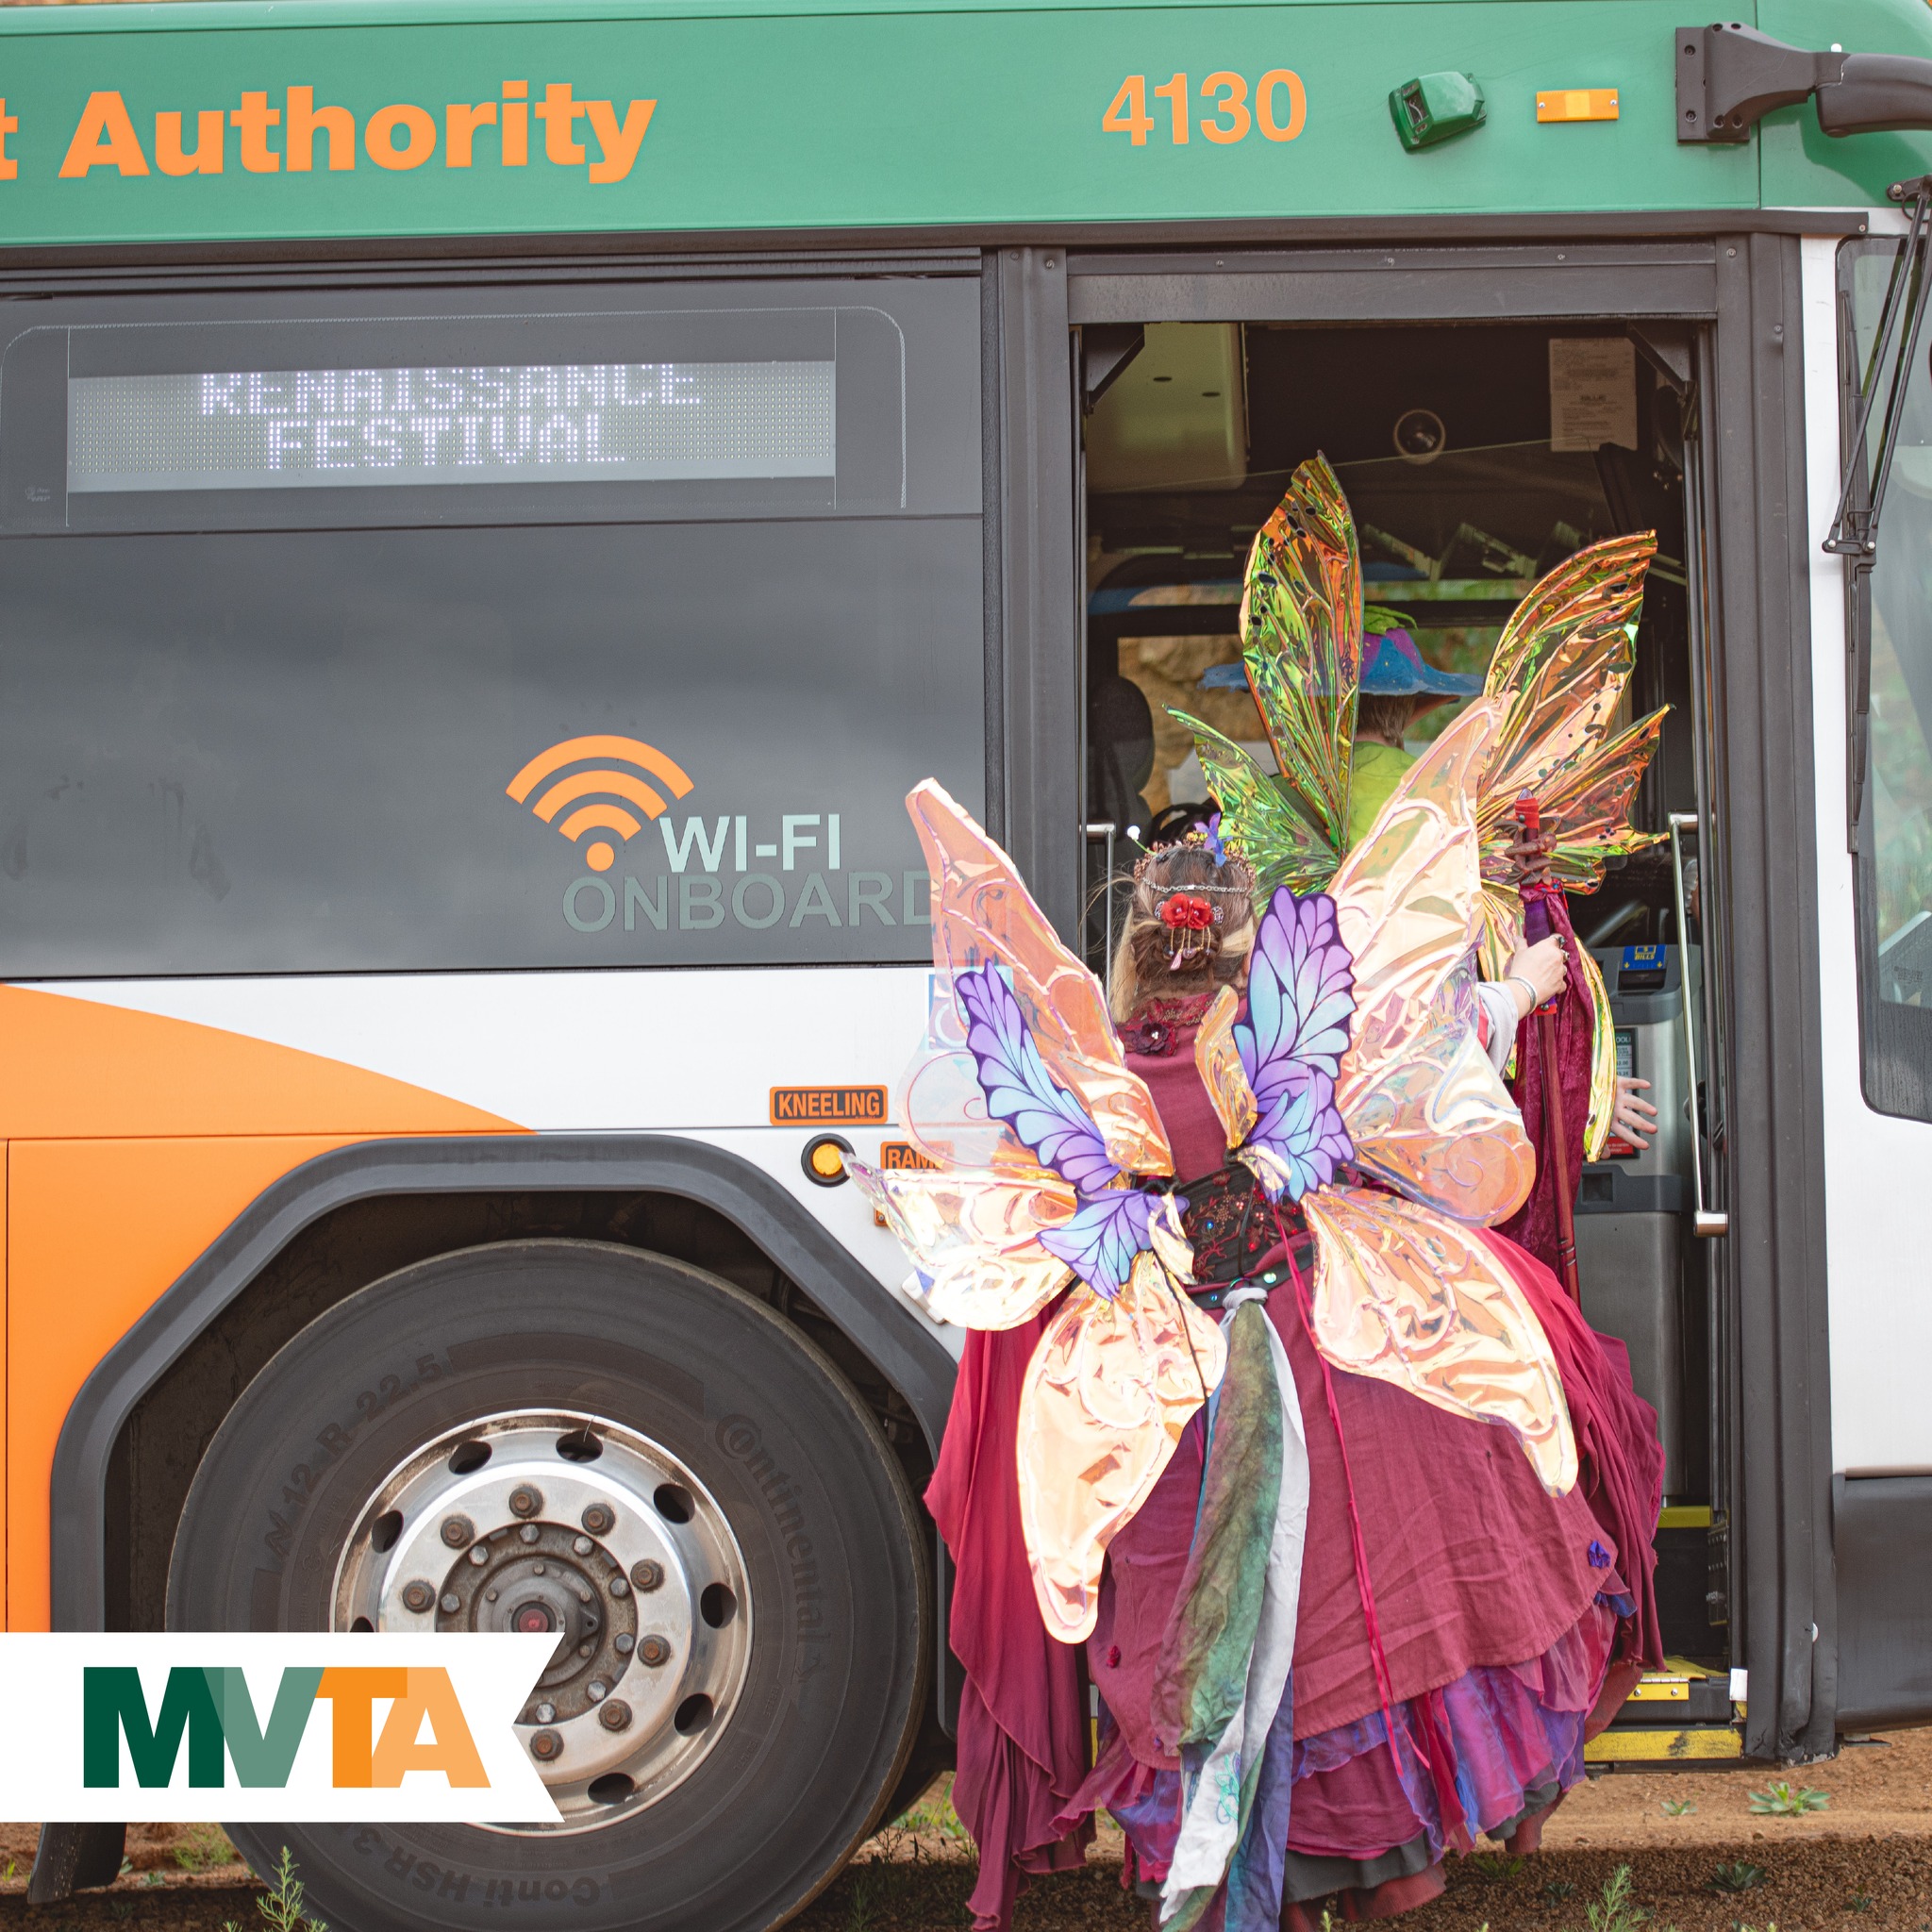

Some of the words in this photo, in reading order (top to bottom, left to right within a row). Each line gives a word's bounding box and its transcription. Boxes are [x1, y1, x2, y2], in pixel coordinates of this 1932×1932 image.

[59, 81, 657, 183] Authority
[1103, 69, 1307, 146] 4130
[200, 363, 701, 416] RENAISSANCE
[268, 414, 625, 470] FESTIVAL
[659, 813, 841, 874] WI-FI
[778, 1091, 880, 1117] KNEELING
[888, 1148, 940, 1170] RAM
[714, 1413, 831, 1646] Continental
[483, 1875, 602, 1907] Conti
